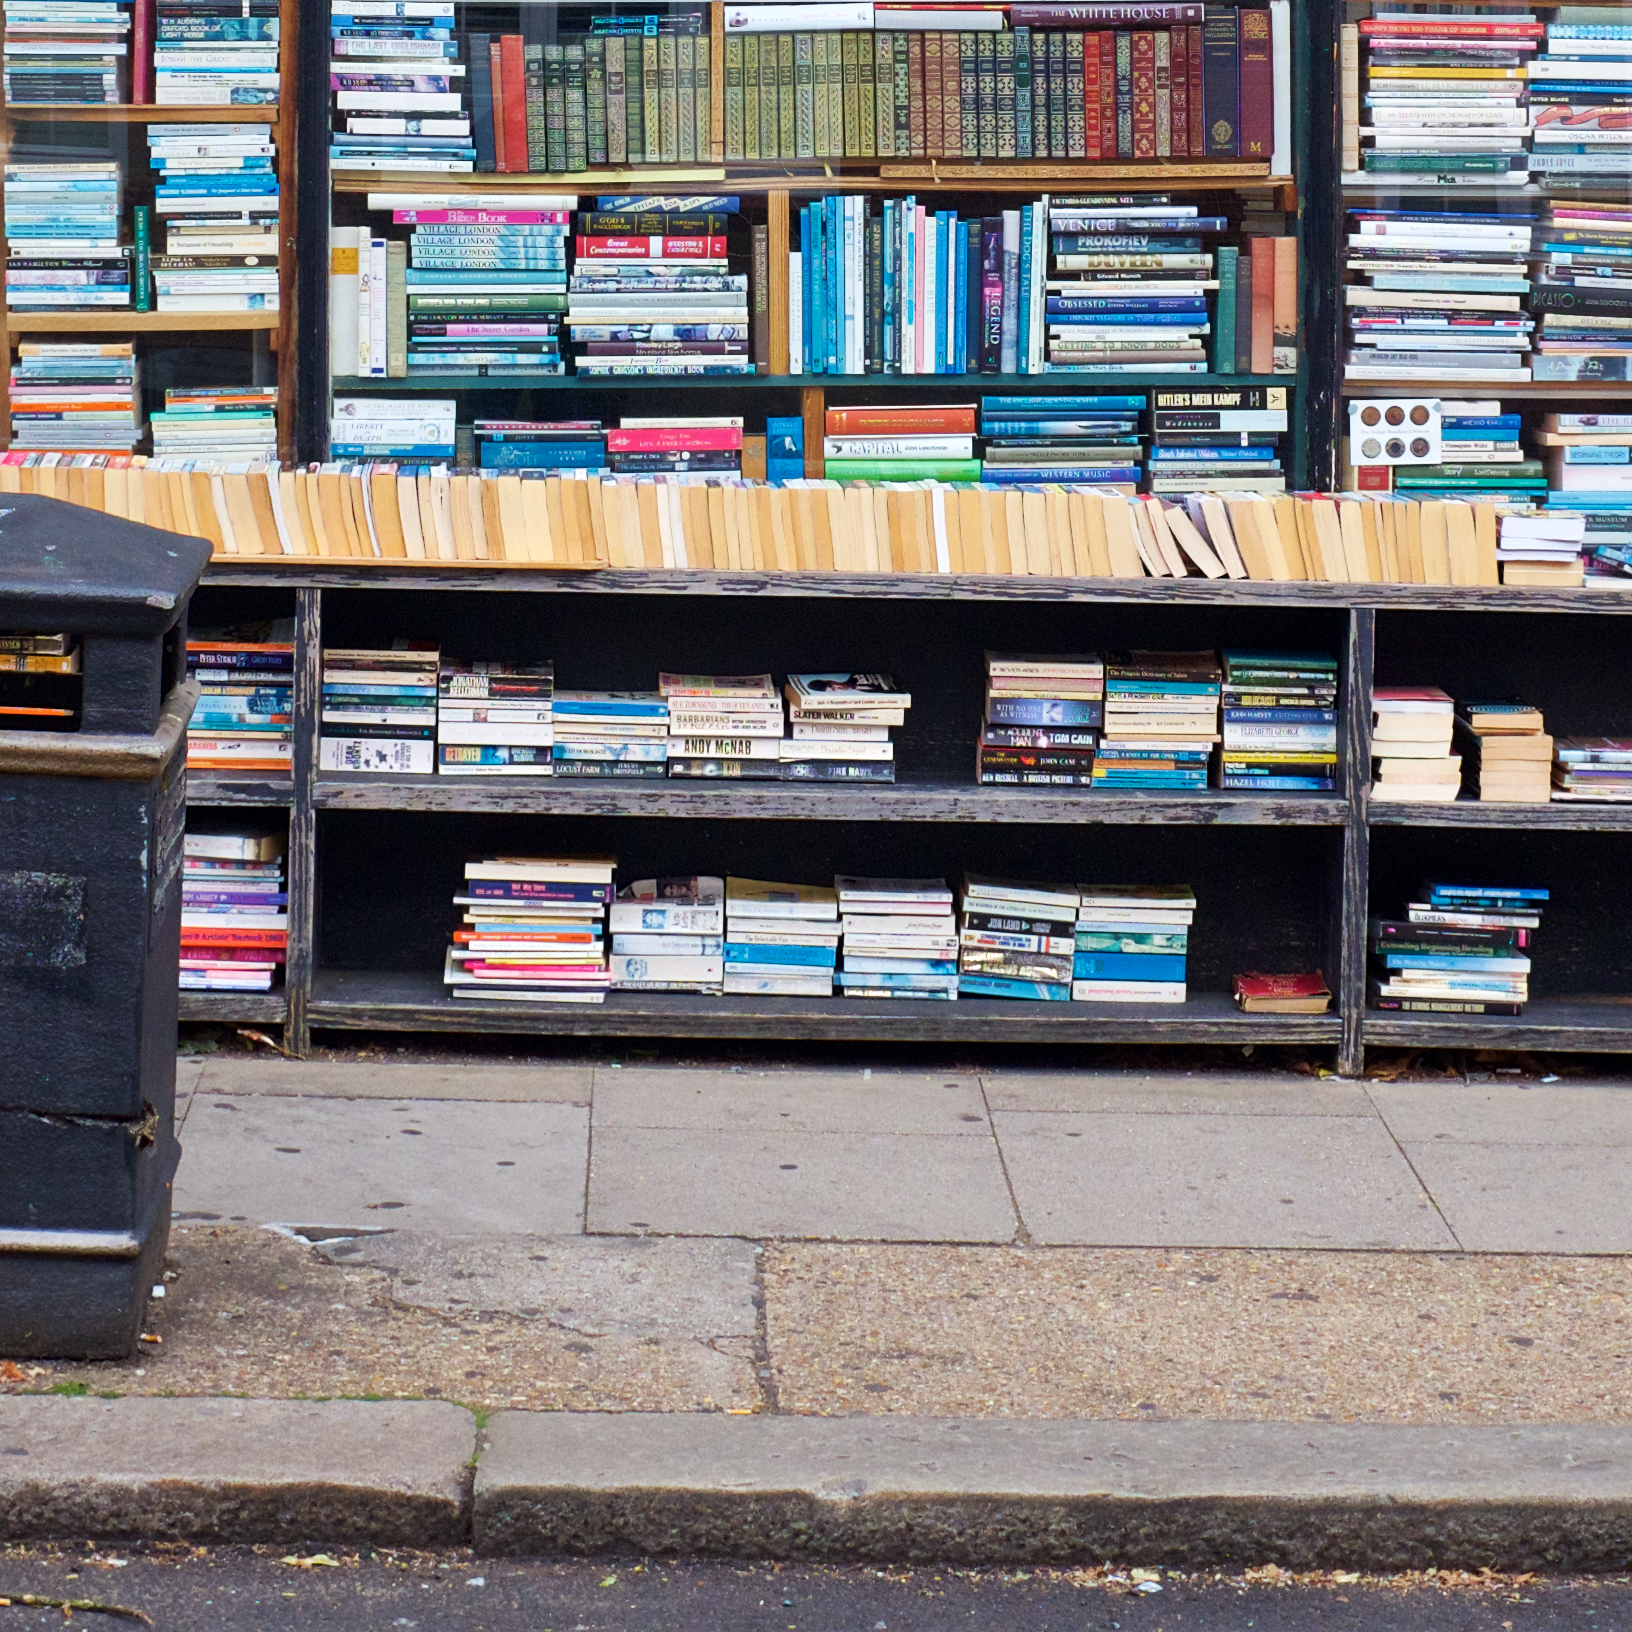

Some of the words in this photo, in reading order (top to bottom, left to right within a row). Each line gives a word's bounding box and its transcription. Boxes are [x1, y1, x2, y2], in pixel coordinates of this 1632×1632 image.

[1069, 8, 1117, 20] WHITE
[1120, 8, 1169, 19] HOUSE
[479, 212, 507, 223] BOOK
[422, 225, 459, 235] VILLAGE
[461, 225, 501, 235] LONDON
[1058, 218, 1115, 232] VENICE
[414, 235, 454, 246] VILLAGE
[457, 235, 497, 246] LONDON
[1077, 235, 1149, 248] PROKOFIEV
[414, 247, 454, 257] VILLAGE
[457, 247, 497, 257] LONDON
[415, 259, 455, 269] VILLAGE
[458, 259, 497, 269] LONDON
[1058, 299, 1106, 310] OBSESSED
[990, 292, 1000, 345] LEGEND
[848, 441, 902, 455] CAPITAL
[1040, 469, 1080, 480] WESTERN
[1083, 469, 1112, 480] MUSIC
[451, 675, 489, 688] JONATHAN
[450, 685, 489, 697] KELLERMAN
[1048, 733, 1067, 745] TOM
[1068, 733, 1093, 745] CAIN
[683, 738, 715, 754] ANDY
[718, 738, 751, 755] McNAB
[1225, 777, 1253, 787] HAZEL
